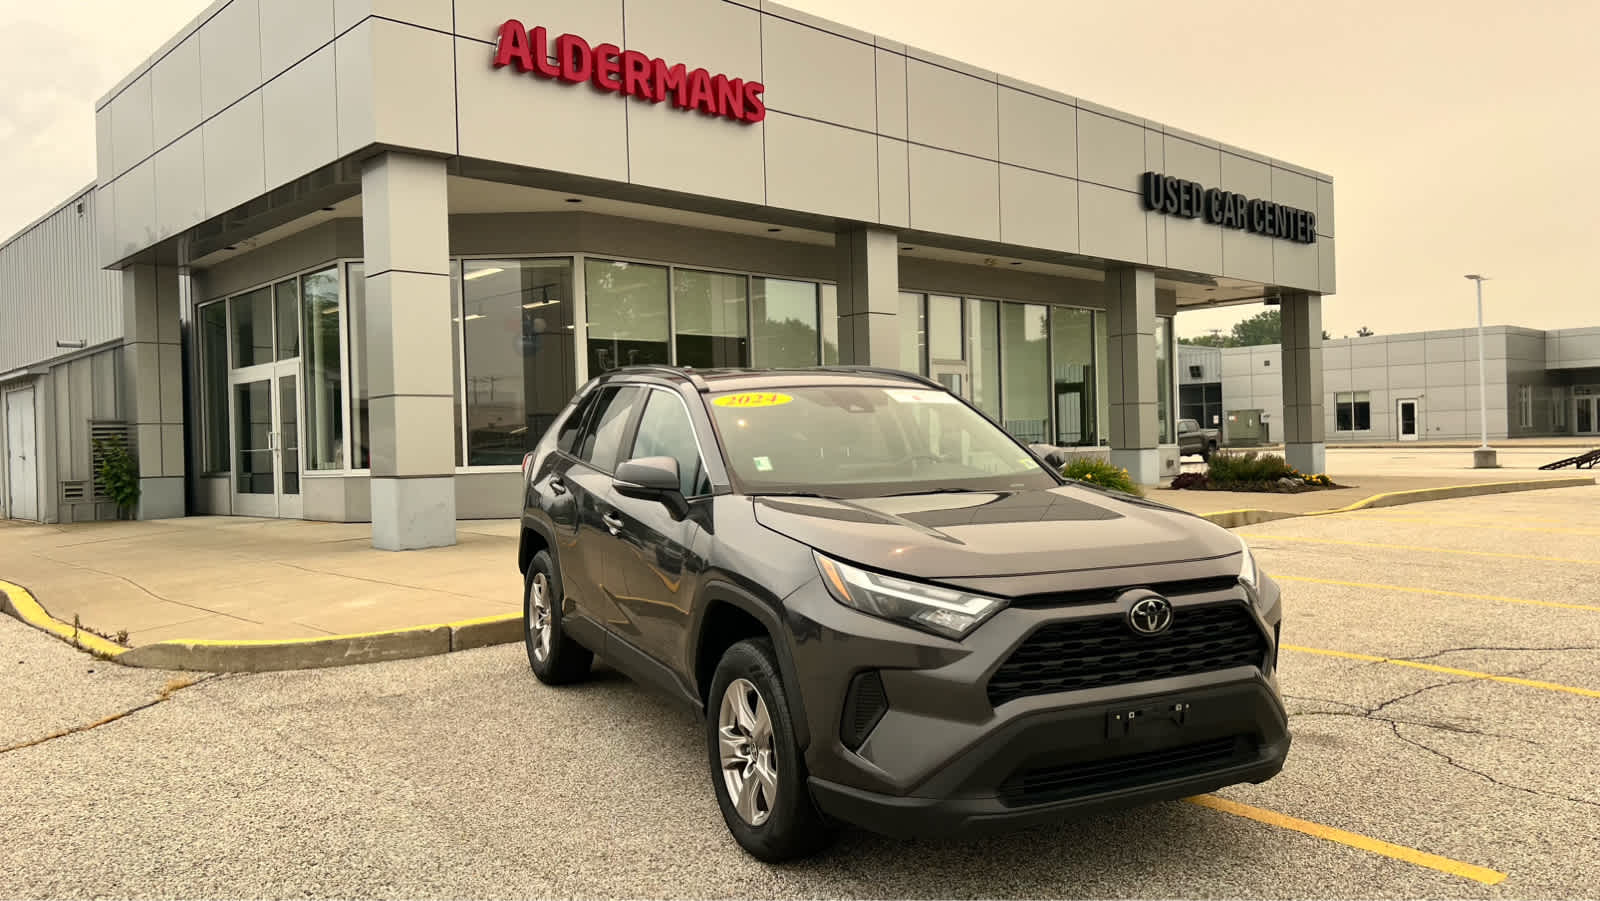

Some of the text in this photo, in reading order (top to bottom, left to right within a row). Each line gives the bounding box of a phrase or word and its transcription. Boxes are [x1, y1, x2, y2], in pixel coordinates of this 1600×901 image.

[493, 19, 766, 123] ALDERMANS
[1144, 172, 1316, 244] USED CAR CENTER
[726, 394, 777, 405] 2024
